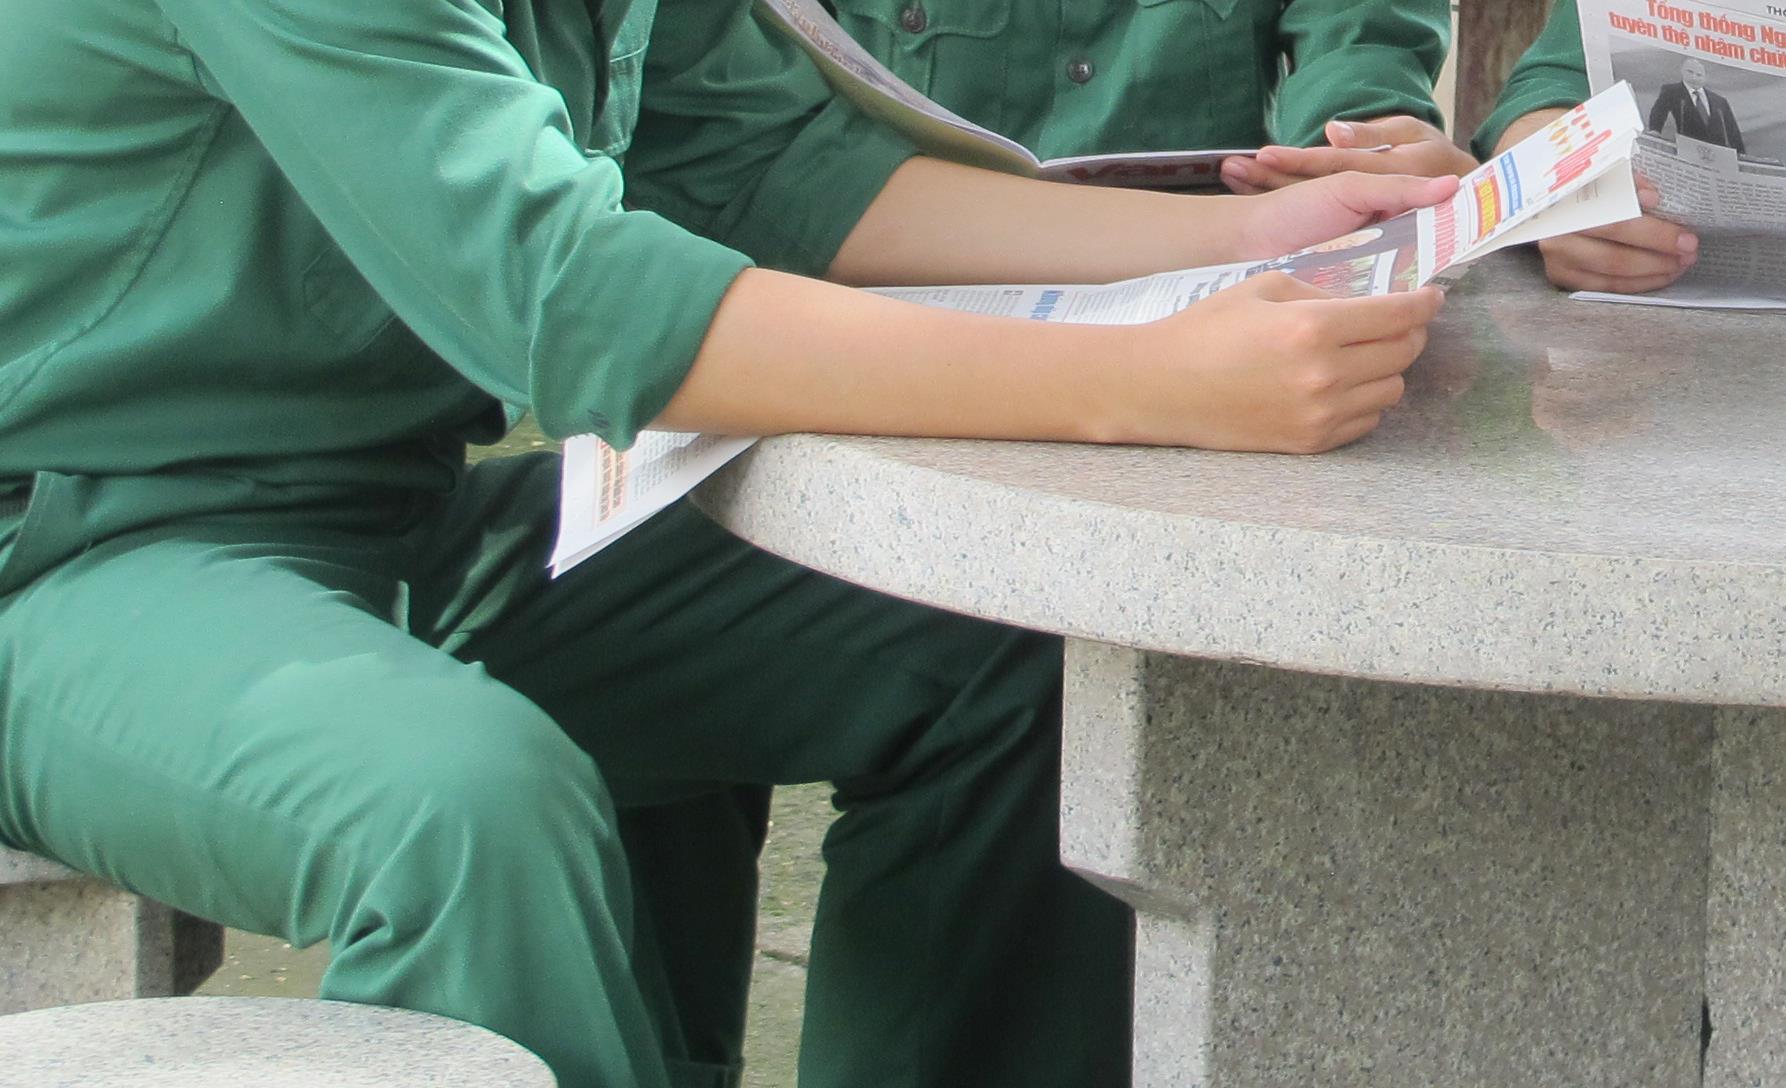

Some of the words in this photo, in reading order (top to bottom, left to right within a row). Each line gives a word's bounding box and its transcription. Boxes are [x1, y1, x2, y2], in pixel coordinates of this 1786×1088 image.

[1609, 11, 1658, 38] tuyên
[1661, 24, 1690, 50] thệ
[1694, 34, 1745, 61] nhậm
[1698, 11, 1756, 42] thống
